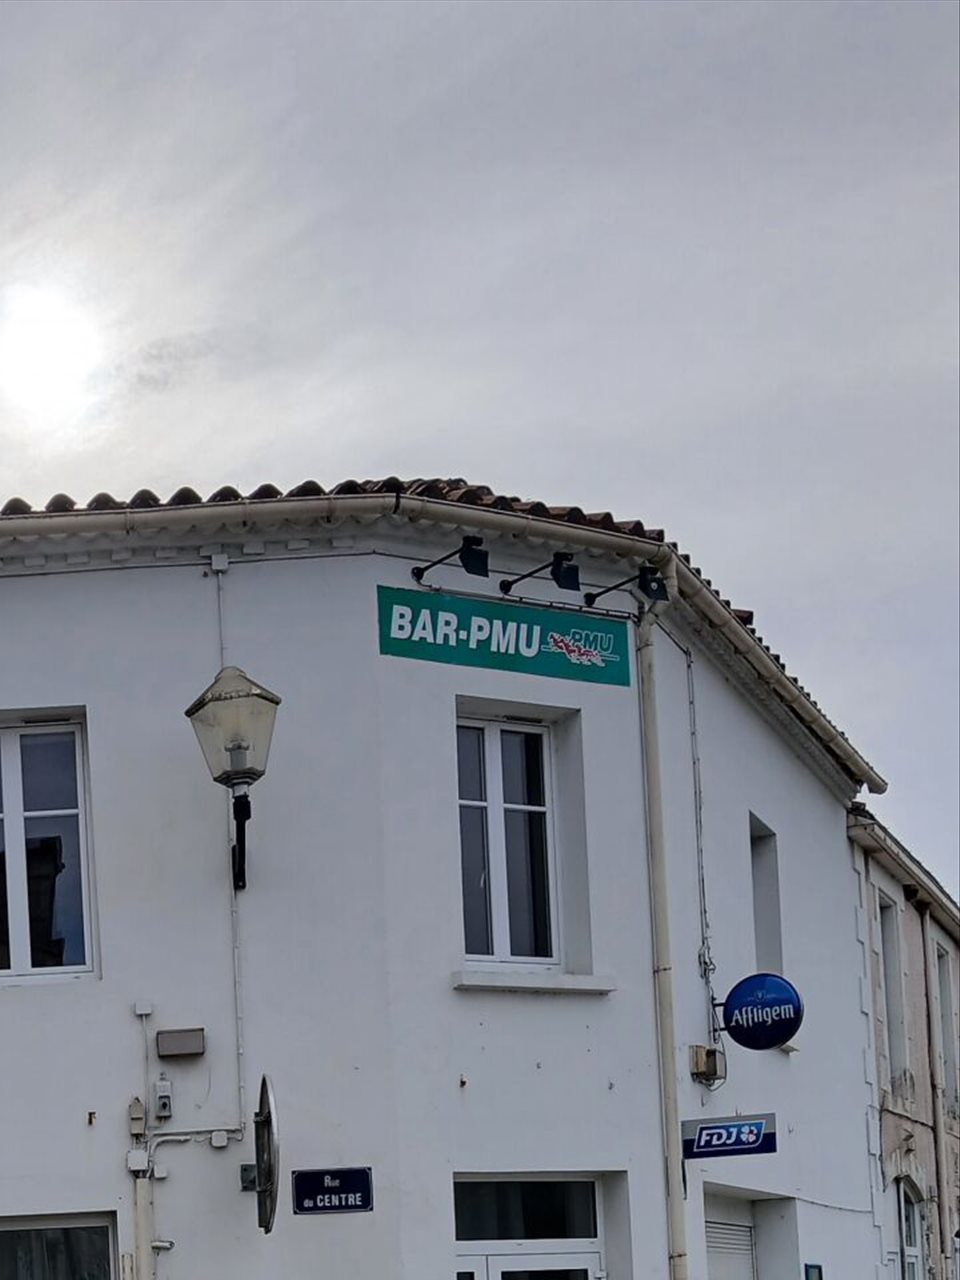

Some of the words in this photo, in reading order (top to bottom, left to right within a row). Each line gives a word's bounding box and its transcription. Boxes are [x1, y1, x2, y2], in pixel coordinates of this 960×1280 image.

[389, 604, 541, 658] BAR-PMU
[569, 628, 614, 654] PMU
[730, 1004, 795, 1028] Affligem
[699, 1129, 738, 1147] FDJ
[324, 1175, 340, 1188] Rue
[303, 1198, 314, 1208] du
[316, 1193, 363, 1207] CENTRE
